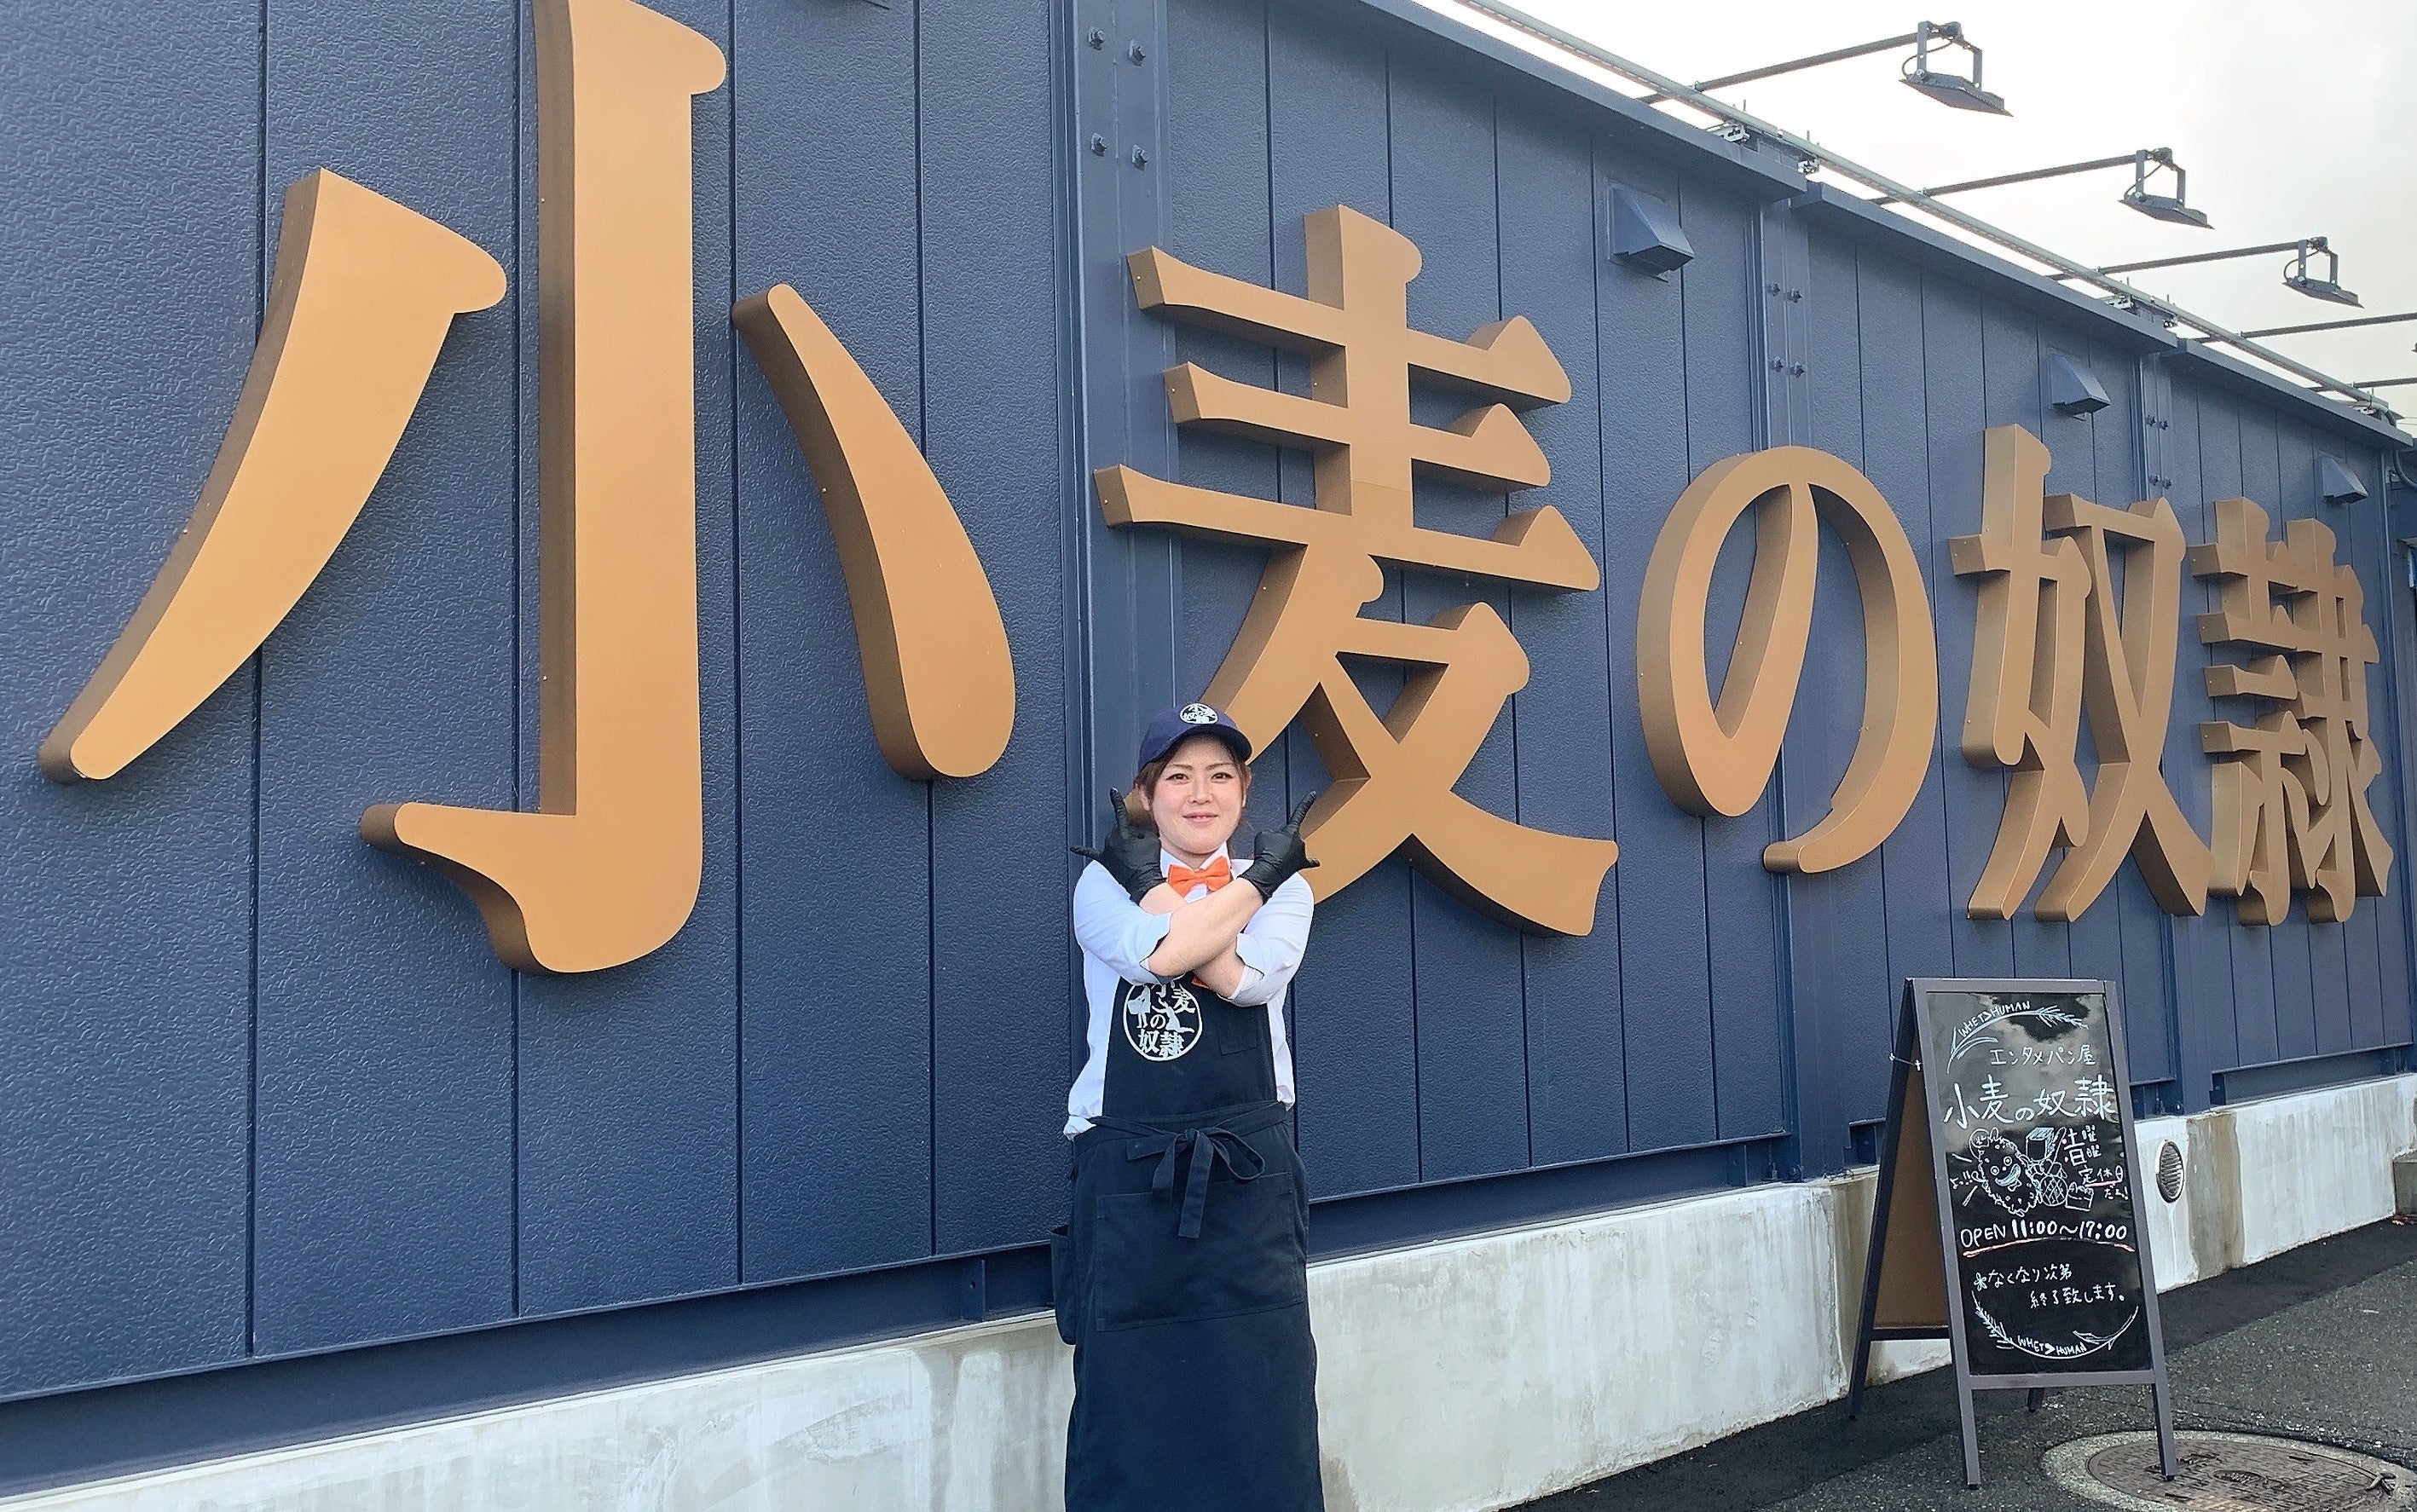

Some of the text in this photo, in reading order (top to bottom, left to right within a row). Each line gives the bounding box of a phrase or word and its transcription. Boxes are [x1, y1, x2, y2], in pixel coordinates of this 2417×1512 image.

[38, 0, 2394, 972] 小麦の奴隷
[1150, 1014, 1166, 1029] の
[1137, 1029, 1185, 1058] 奴隷
[1990, 1044, 2096, 1065] エンタメパン屋
[1943, 1074, 2116, 1129] 小麦の奴隷
[2079, 1164, 2123, 1185] 定休日
[1961, 1223, 2006, 1248] OPEN
[2029, 1282, 2125, 1309] 終了致します。
